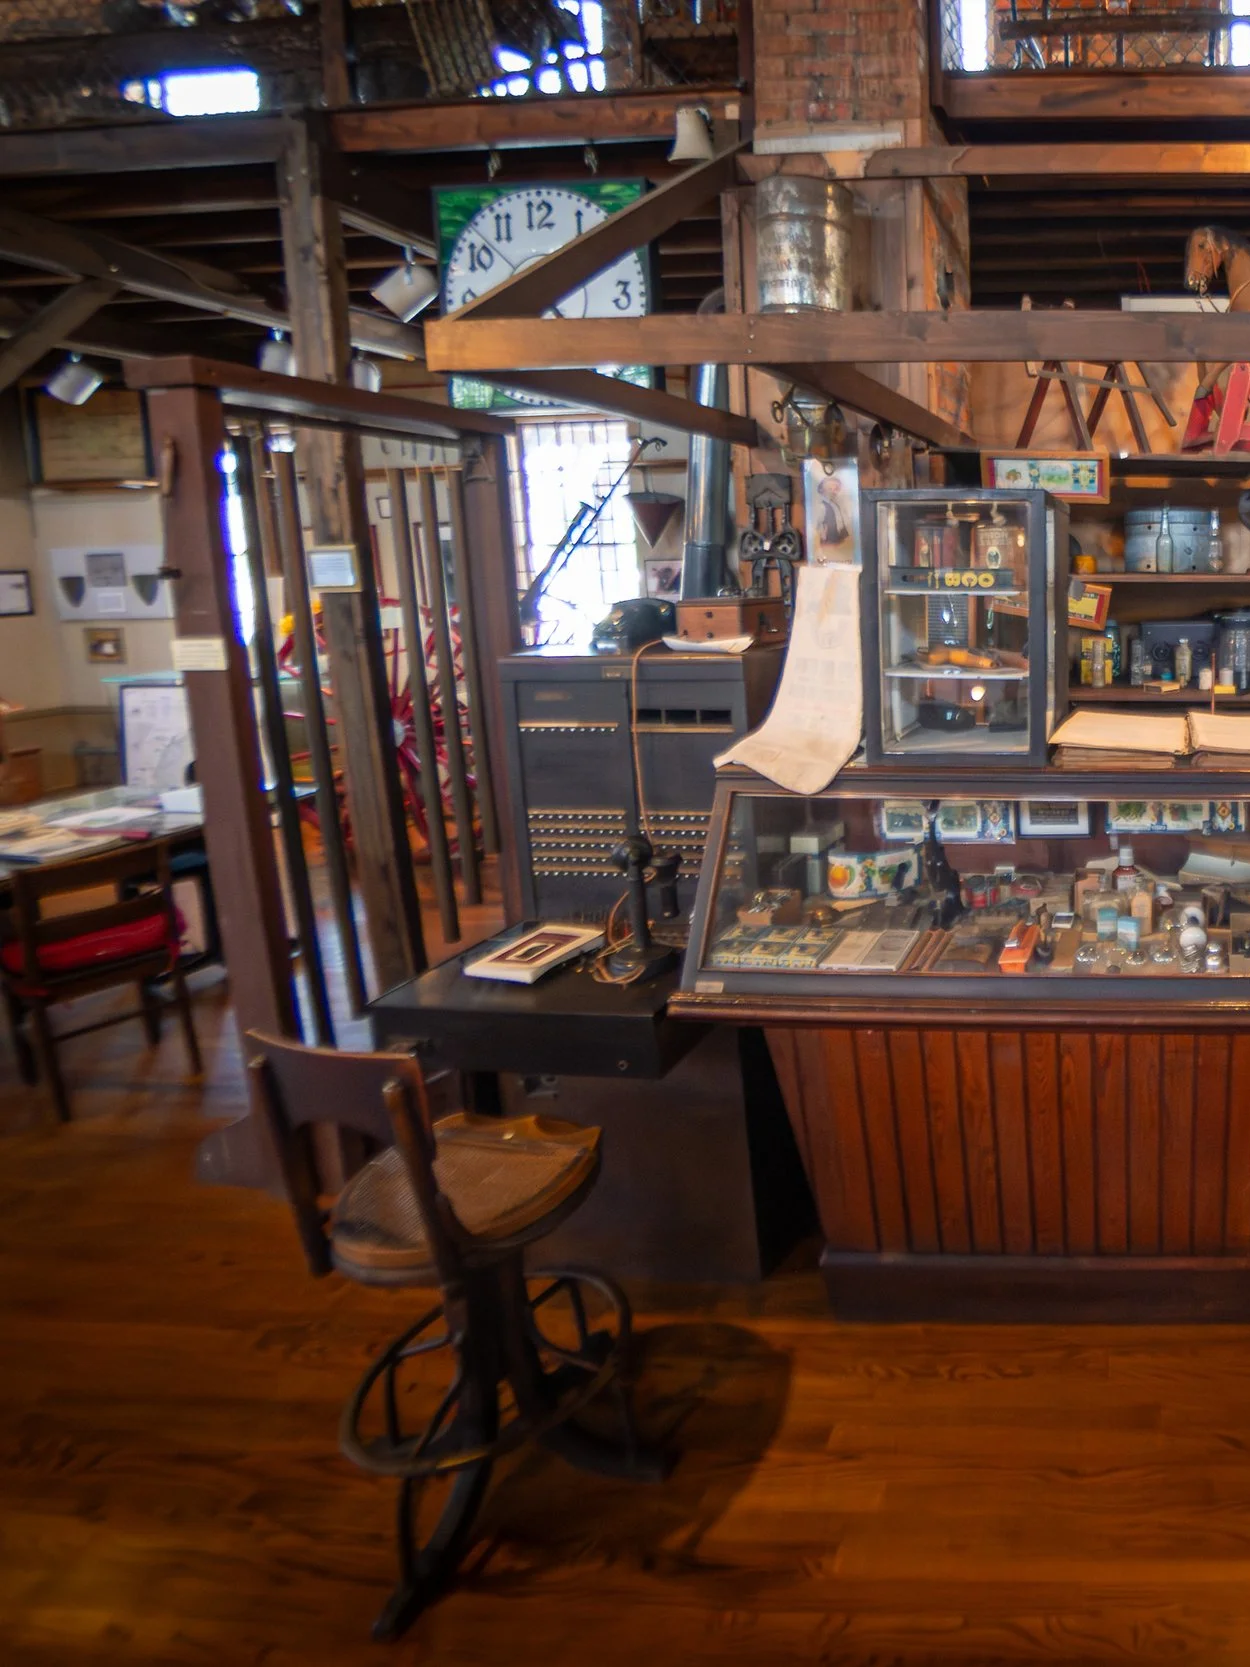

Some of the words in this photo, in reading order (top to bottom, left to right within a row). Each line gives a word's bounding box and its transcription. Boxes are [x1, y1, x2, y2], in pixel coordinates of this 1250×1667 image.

[494, 212, 513, 243] 11
[525, 200, 555, 231] 12
[468, 242, 494, 273] 10
[612, 279, 631, 311] 3
